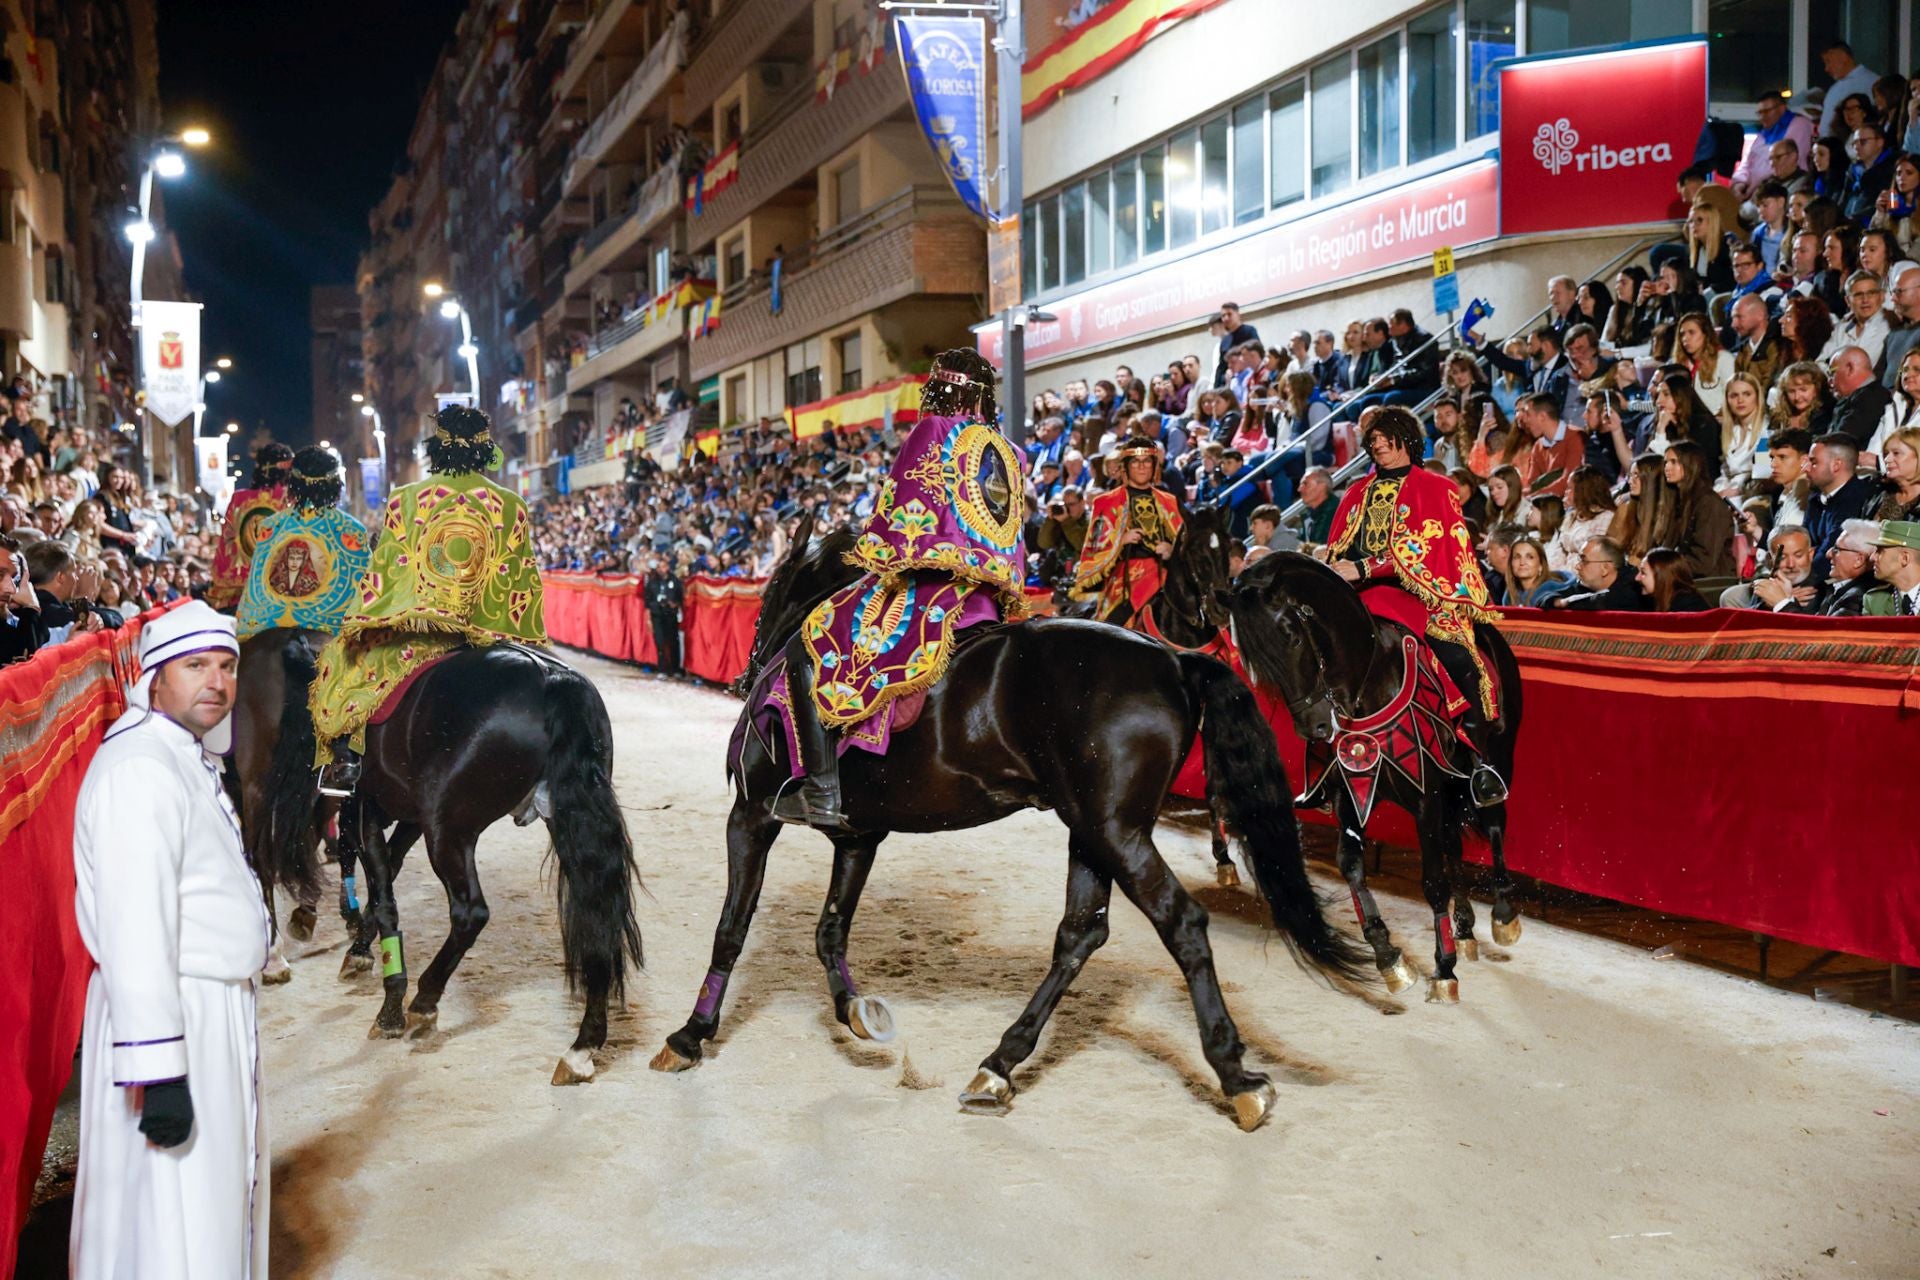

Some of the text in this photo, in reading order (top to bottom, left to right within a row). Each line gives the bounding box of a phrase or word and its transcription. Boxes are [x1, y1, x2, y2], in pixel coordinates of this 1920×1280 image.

[1575, 142, 1673, 172] ribera
[1095, 300, 1129, 333] Grupo
[1267, 253, 1285, 279] en
[1289, 241, 1305, 273] la
[1309, 220, 1367, 272] Región
[1371, 213, 1395, 249] de
[1399, 192, 1467, 243] Murcia
[1438, 259, 1450, 275] 31
